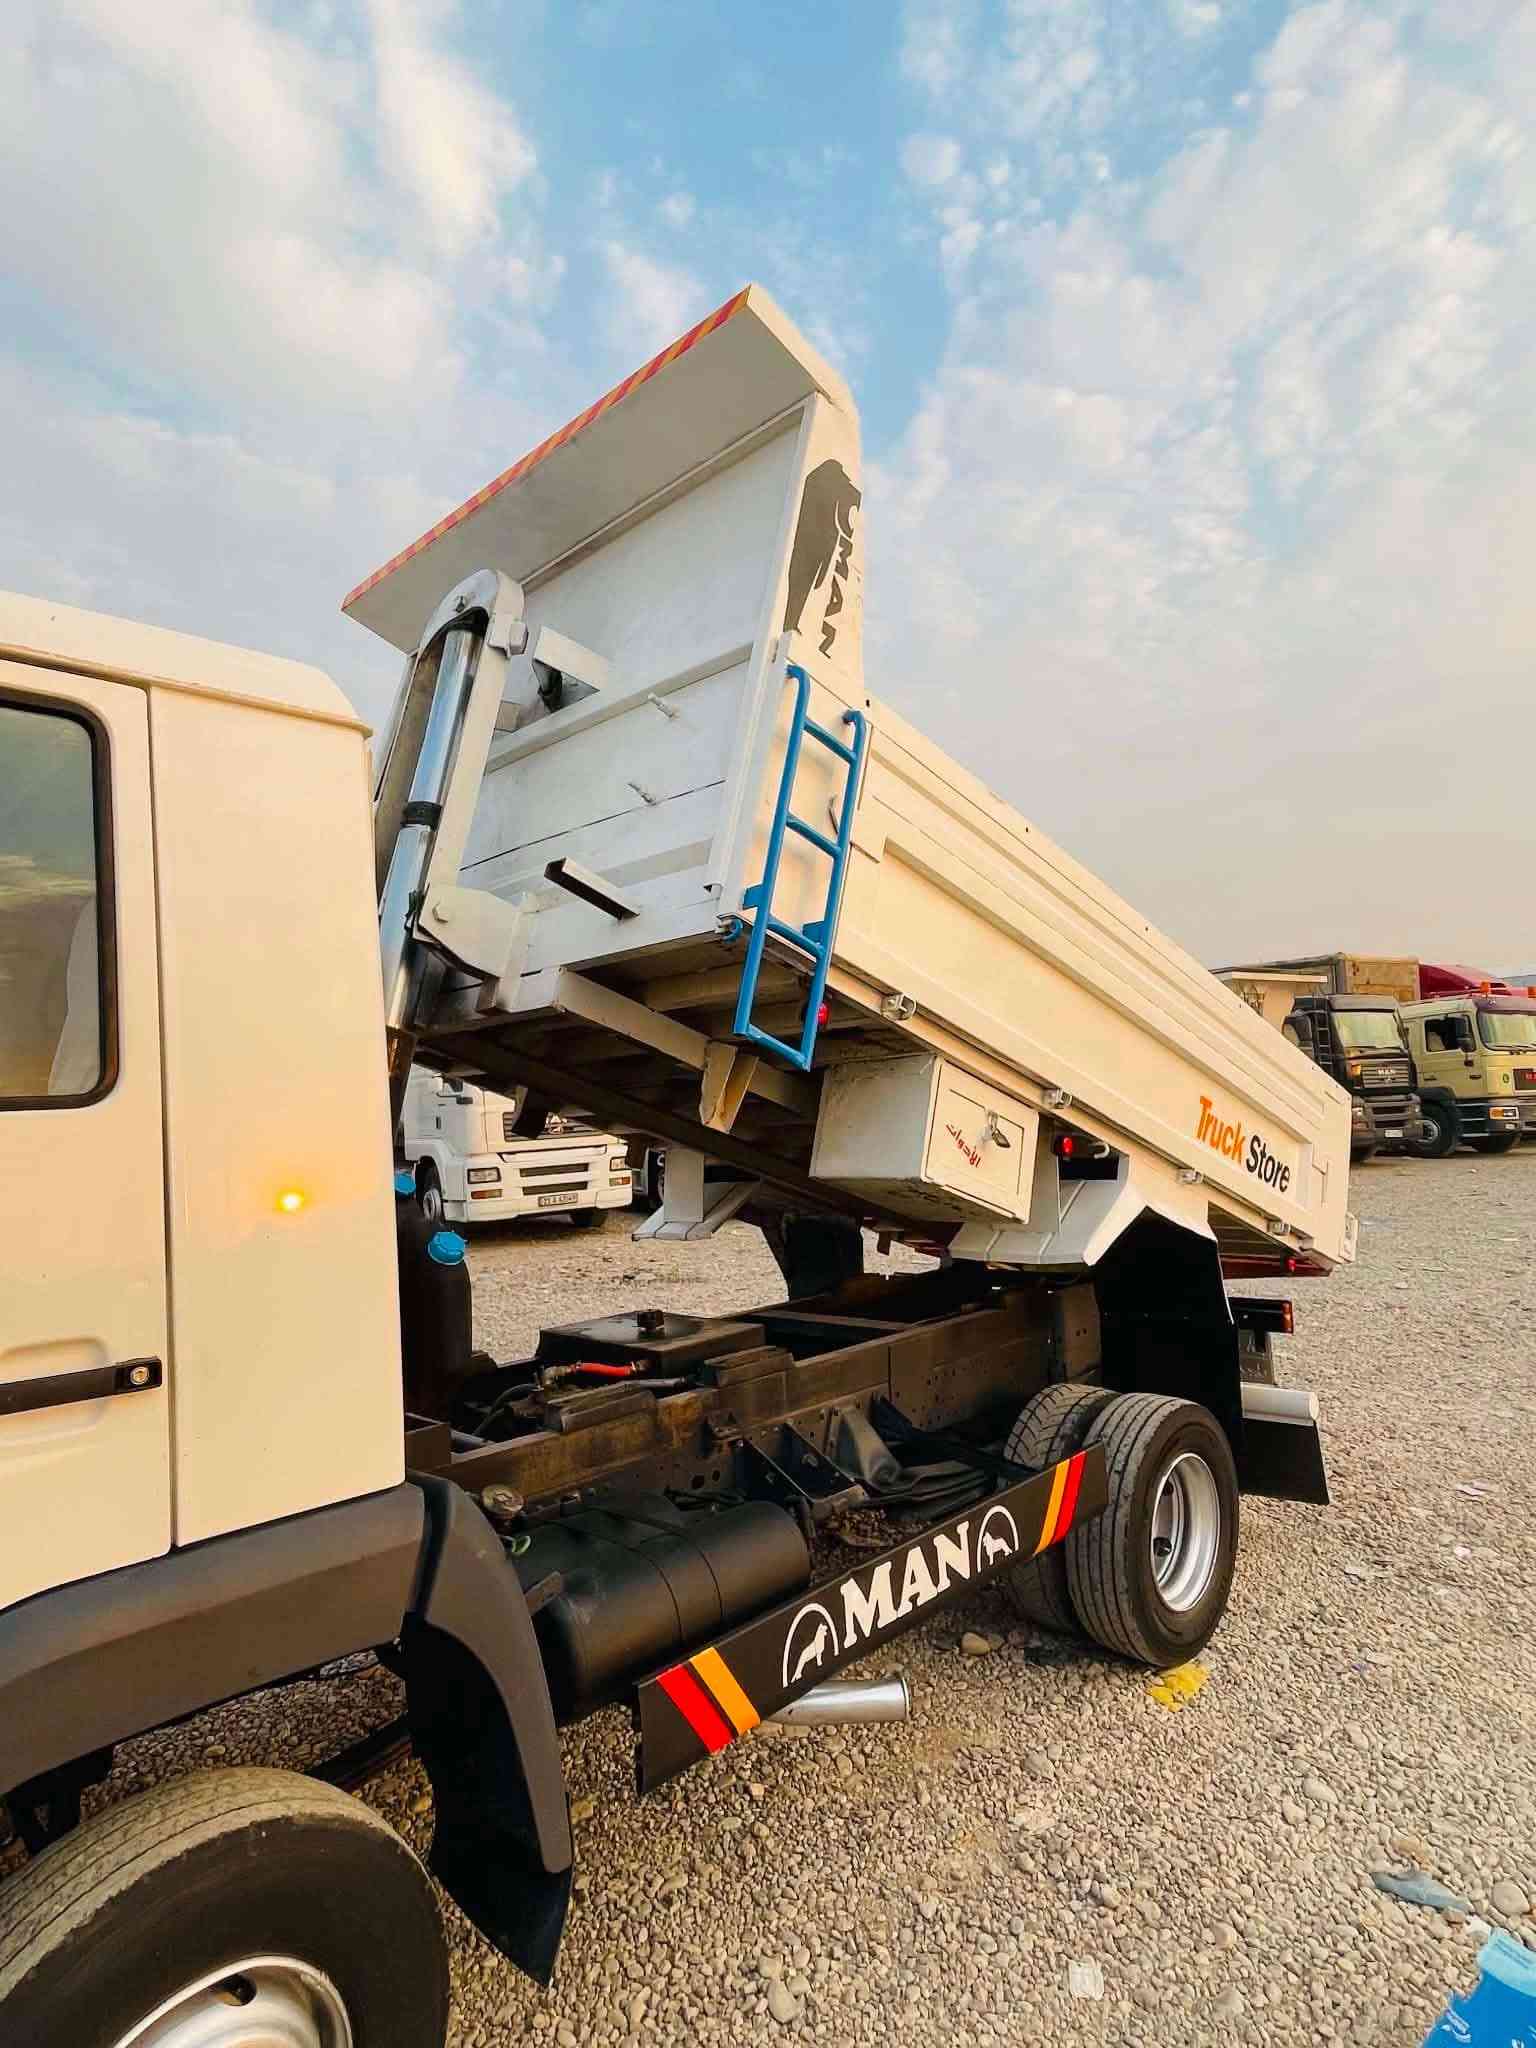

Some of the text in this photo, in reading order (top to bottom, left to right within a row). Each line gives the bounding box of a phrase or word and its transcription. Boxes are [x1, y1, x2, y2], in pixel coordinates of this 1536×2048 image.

[818, 533, 853, 659] MAN
[1196, 1095, 1291, 1193] Truck Store
[840, 1520, 970, 1649] MAN
